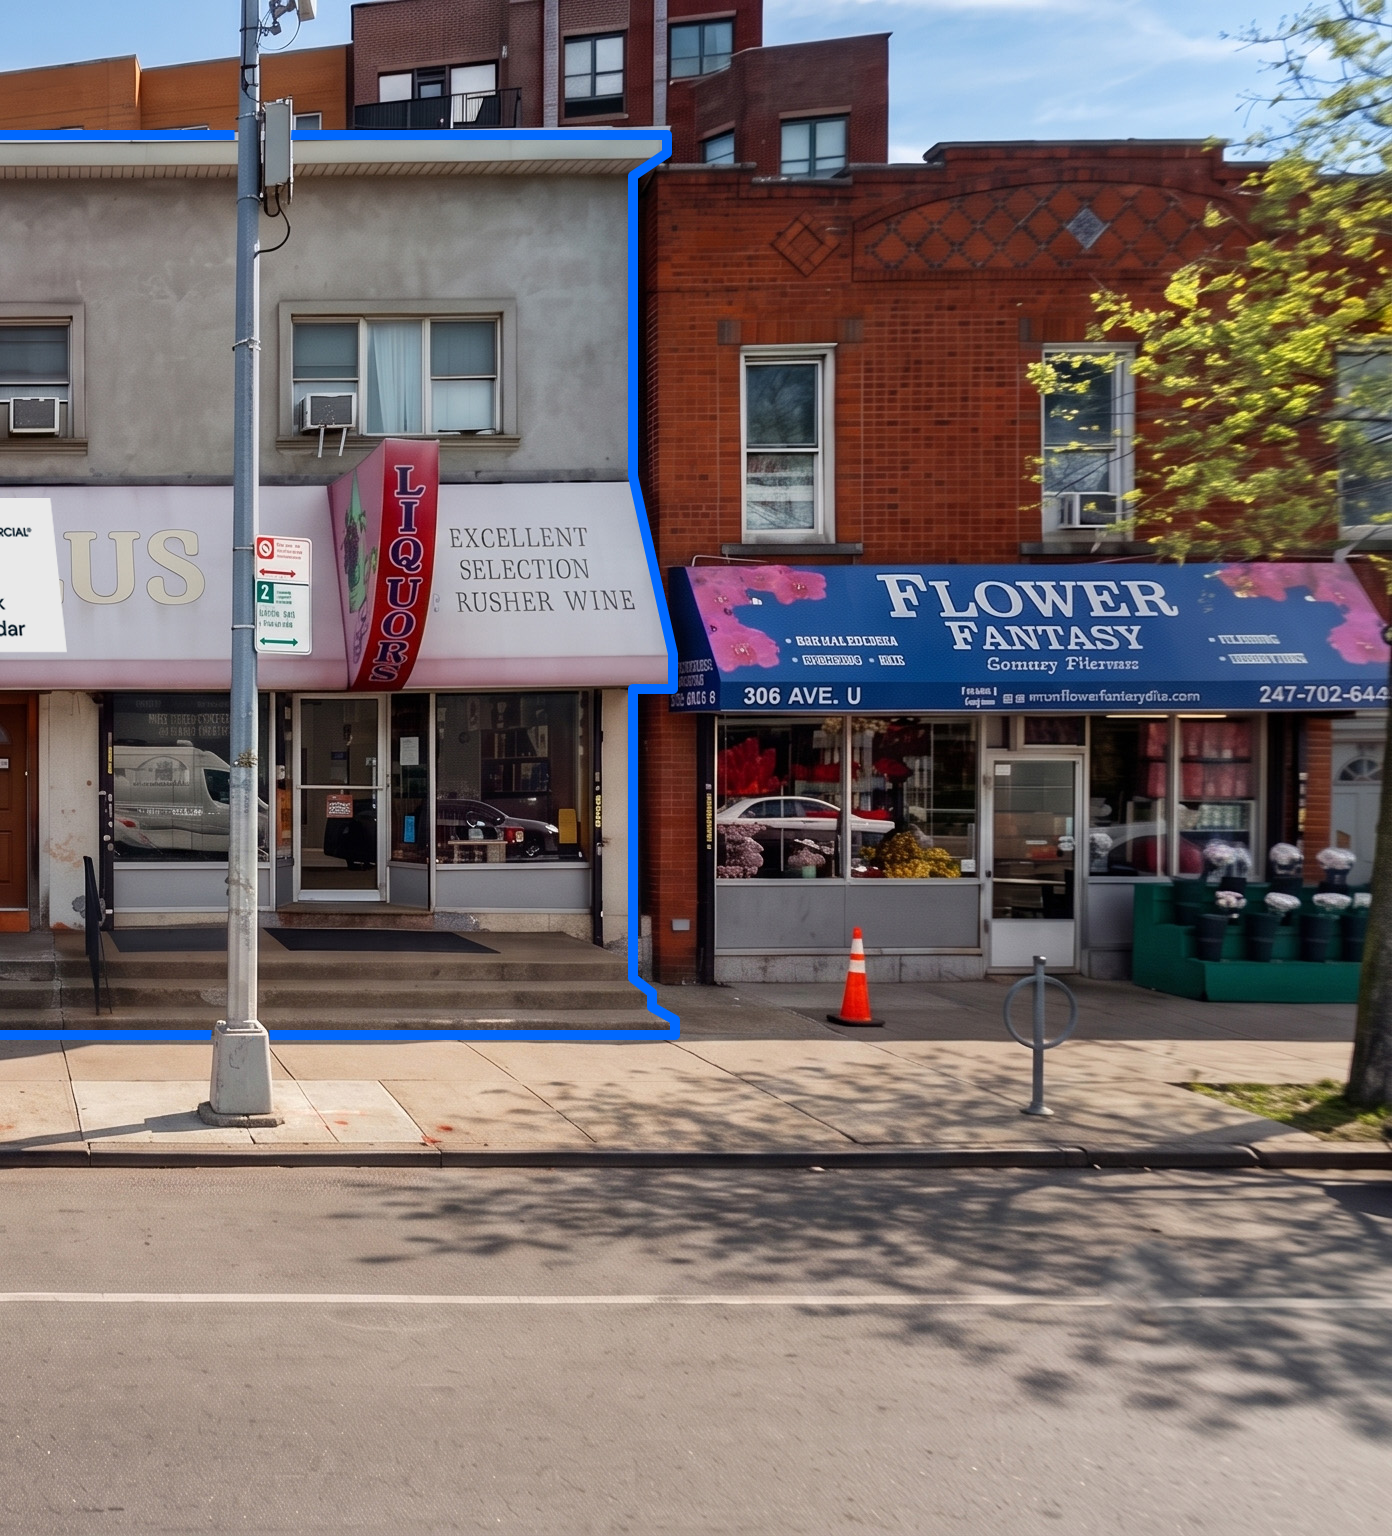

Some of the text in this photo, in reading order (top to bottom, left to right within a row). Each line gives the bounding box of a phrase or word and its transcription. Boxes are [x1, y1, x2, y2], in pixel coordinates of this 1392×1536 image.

[450, 527, 588, 549] EXCELLENT
[59, 529, 205, 605] US
[368, 464, 426, 682] LIQUORS
[459, 558, 590, 580] SELECTION
[260, 584, 270, 600] 2
[456, 591, 554, 613] RUSHER
[564, 589, 636, 611] WINE
[876, 573, 1180, 619] FLOWER
[944, 621, 1145, 651] FANTASY
[743, 687, 862, 705] 306 AVE. U
